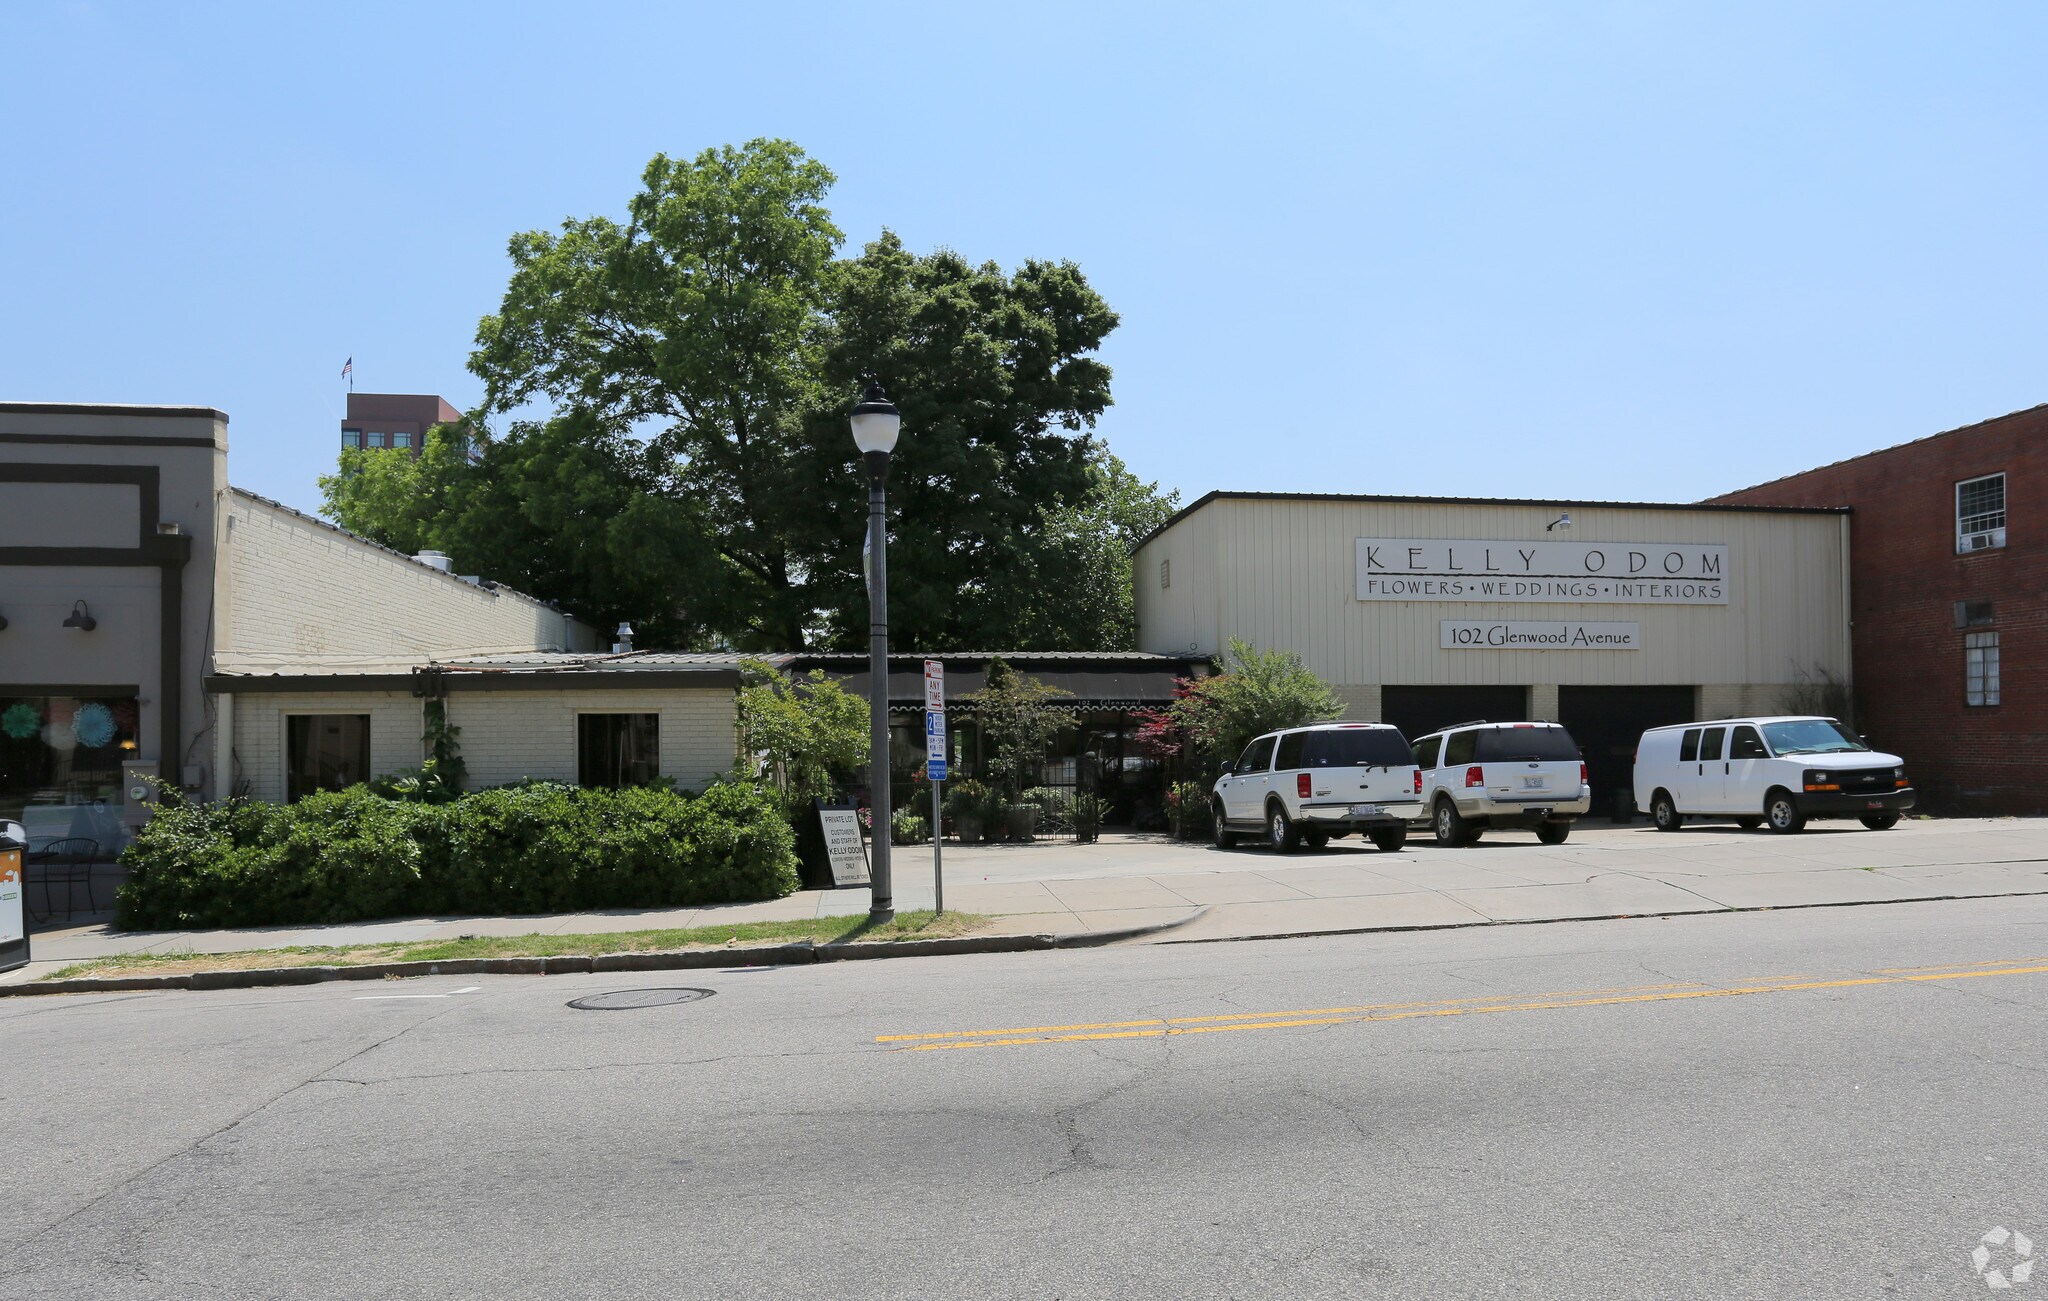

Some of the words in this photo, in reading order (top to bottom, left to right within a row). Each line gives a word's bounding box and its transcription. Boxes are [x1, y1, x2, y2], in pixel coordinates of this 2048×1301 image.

[1366, 546, 1536, 571] KELLY
[1584, 550, 1721, 574] ODOM
[1368, 580, 1463, 595] FLOWERS
[1482, 581, 1598, 597] WEDDINGS
[1615, 583, 1721, 599] INTERIORS
[1452, 628, 1484, 644] 102
[1487, 625, 1567, 646] Glenwood
[1571, 627, 1631, 645] Avenue
[930, 680, 940, 690] ANY
[929, 690, 941, 701] TIME
[929, 716, 933, 730] 2
[829, 847, 847, 855] KELLY
